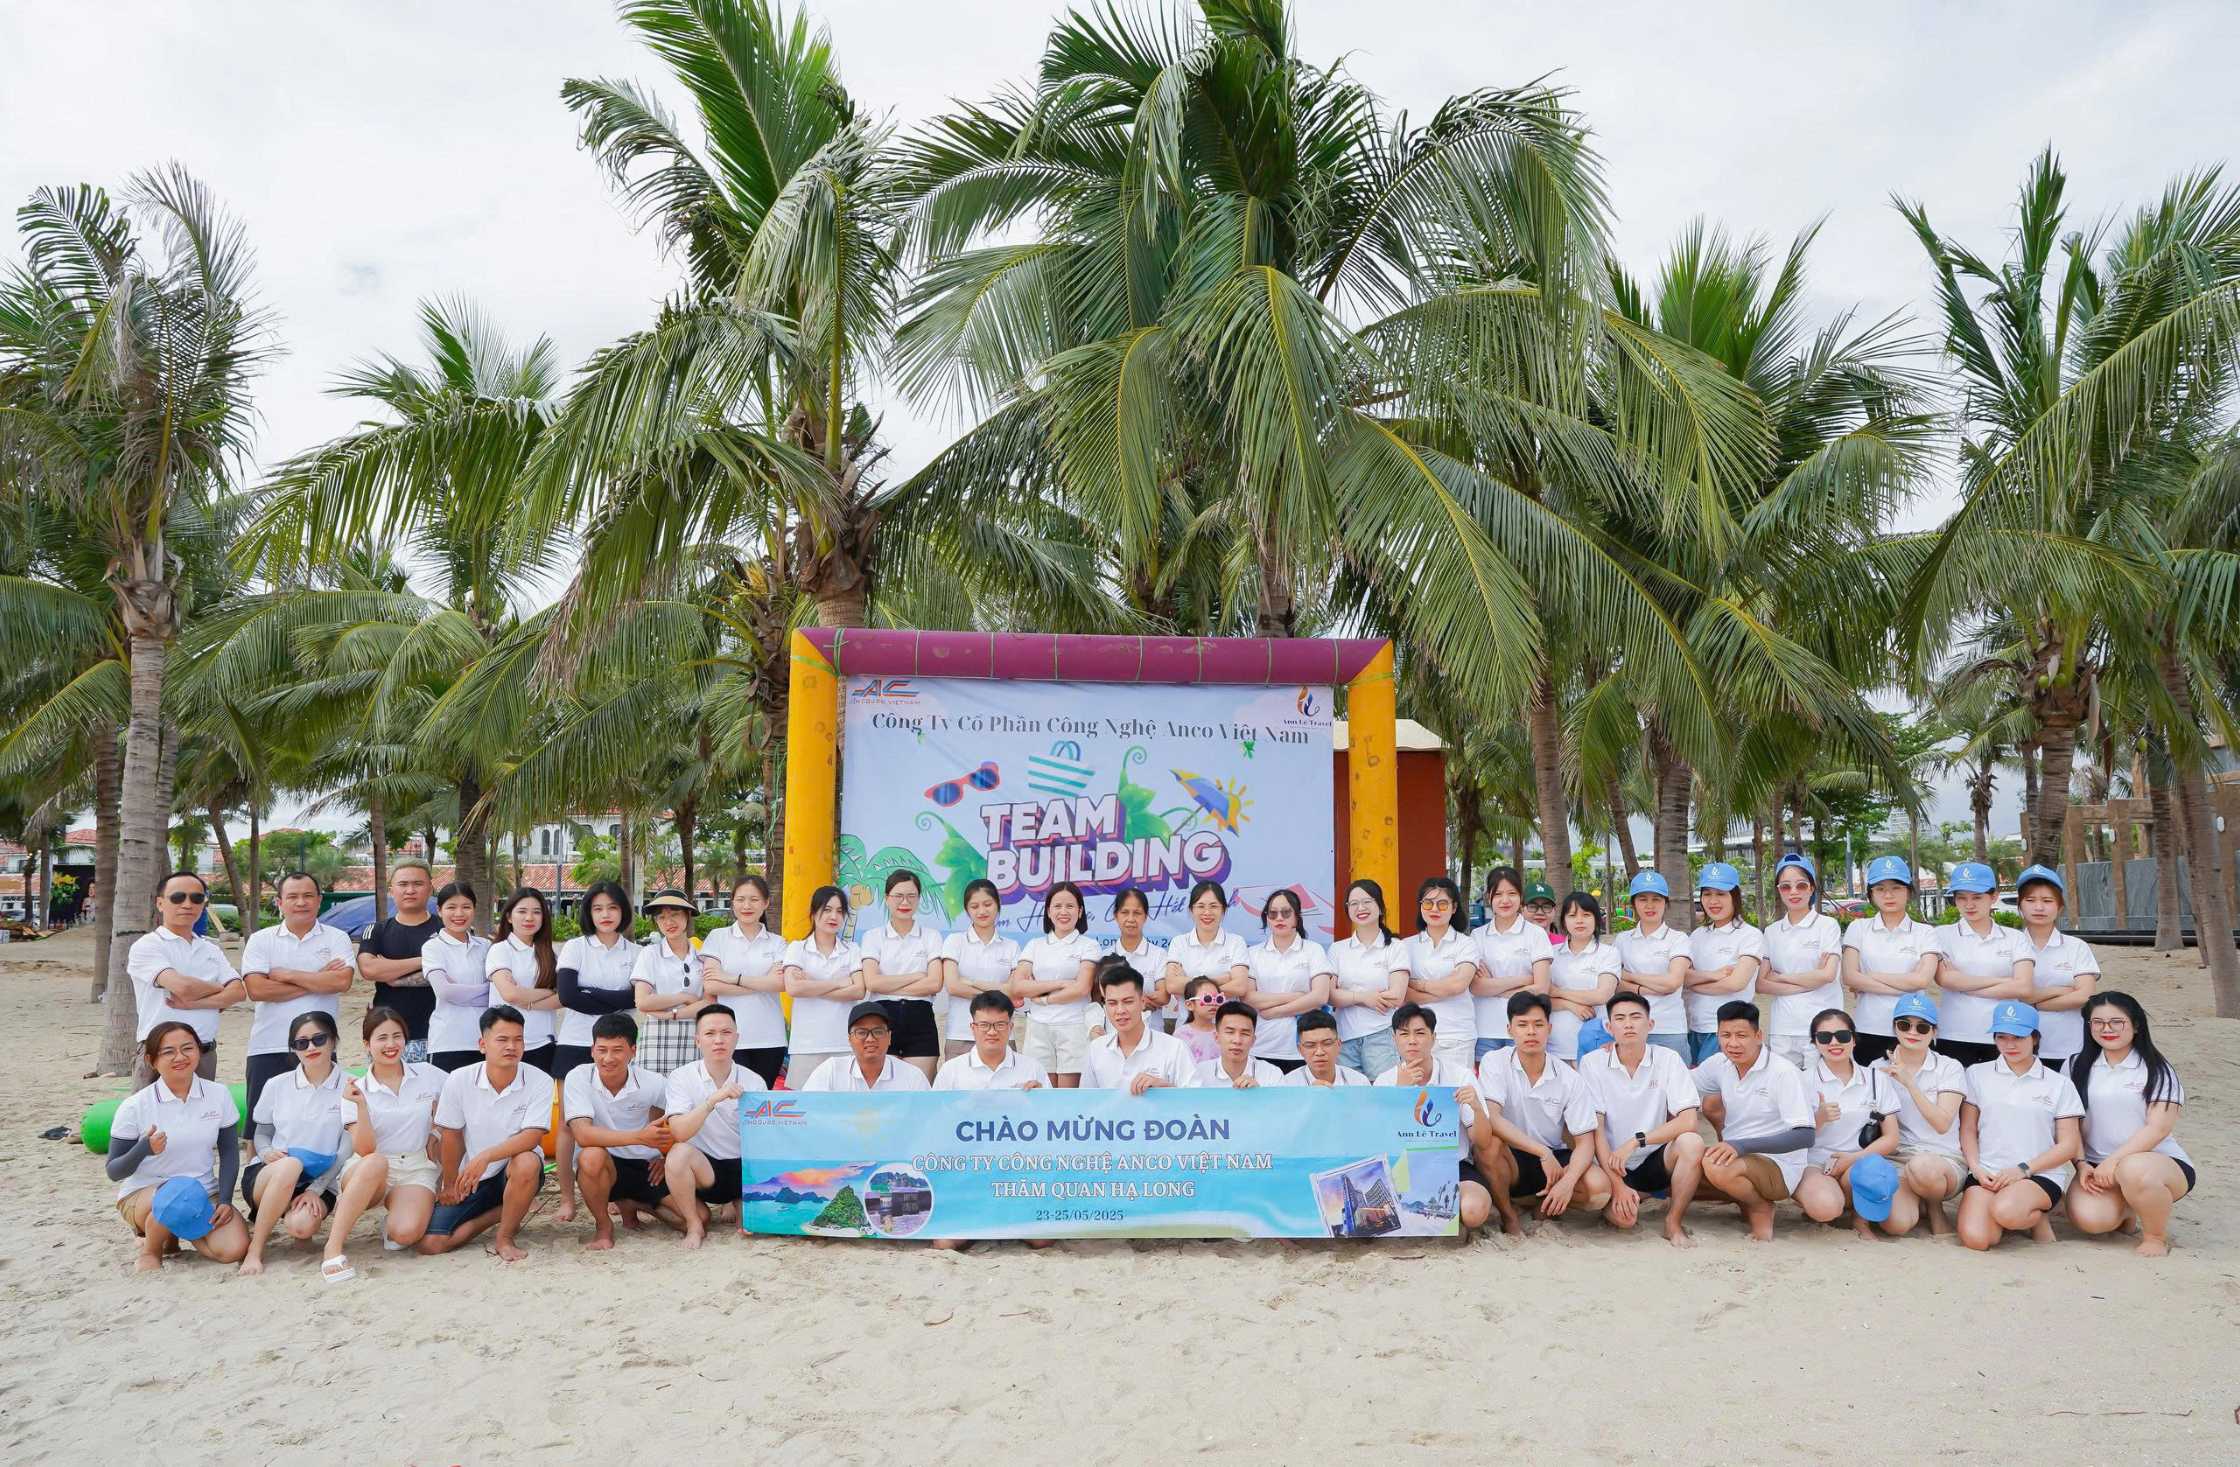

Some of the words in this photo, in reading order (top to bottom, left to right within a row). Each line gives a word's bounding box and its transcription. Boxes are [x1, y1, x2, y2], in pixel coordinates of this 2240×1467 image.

[872, 712, 923, 736] Công
[929, 714, 952, 735] Ty
[990, 713, 1041, 733] Phần
[1047, 716, 1098, 738] Công
[1105, 718, 1157, 740] Nghệ
[1164, 720, 1213, 738] Anco
[1219, 722, 1257, 743] Việt
[1265, 726, 1309, 744] Nam
[980, 793, 1120, 846] TEAM
[986, 830, 1227, 893] BUILDING
[955, 1115, 1039, 1142] CHÀO
[1047, 1114, 1135, 1141] MỪNG
[1144, 1114, 1230, 1141] ĐOÀN
[1429, 1130, 1457, 1138] Travel
[912, 1152, 967, 1172] CÔNG
[970, 1155, 995, 1171] TY
[998, 1152, 1052, 1172] CÔNG
[1056, 1150, 1113, 1174] NGHỆ
[1117, 1153, 1172, 1171] ANCO
[1175, 1151, 1222, 1174] VIỆT
[1225, 1153, 1273, 1170] NAM
[992, 1179, 1047, 1198] THĂM
[1051, 1181, 1106, 1200] QUAN
[1110, 1181, 1138, 1201] HẠ
[1143, 1180, 1196, 1198] LONG
[1035, 1209, 1124, 1222] 23-25/05/2025
